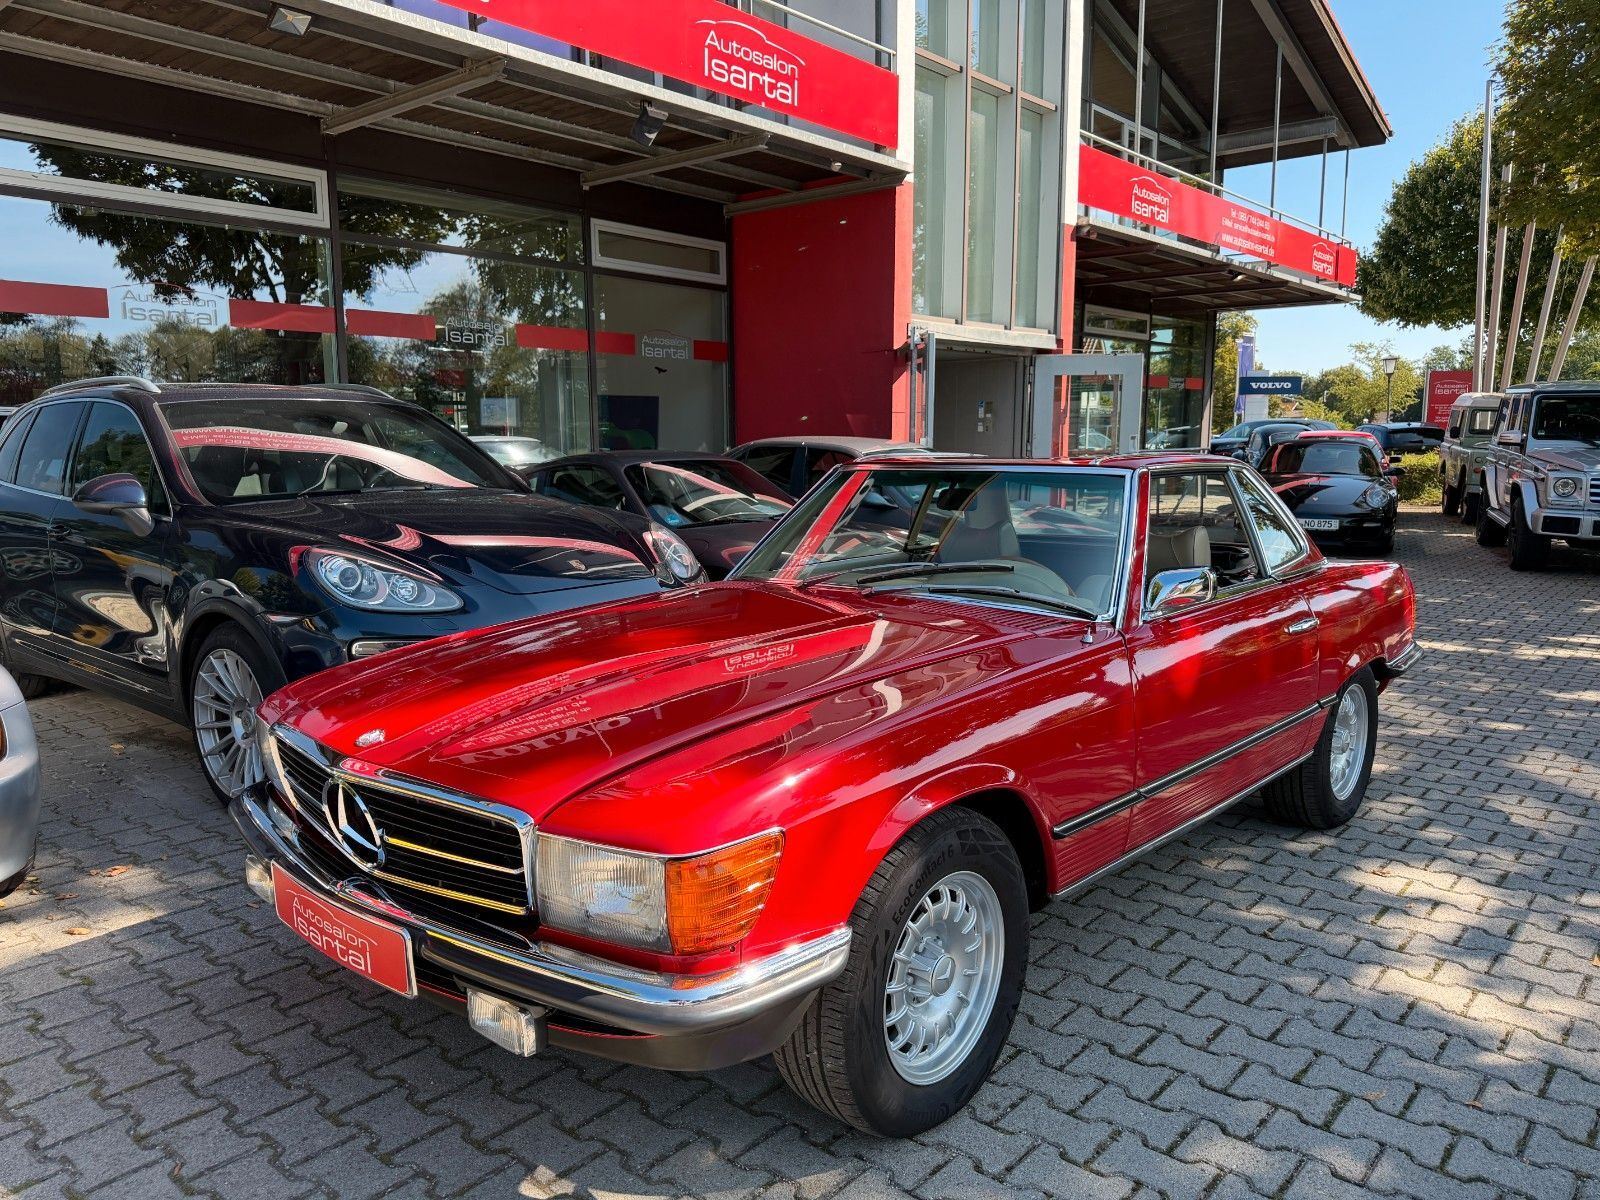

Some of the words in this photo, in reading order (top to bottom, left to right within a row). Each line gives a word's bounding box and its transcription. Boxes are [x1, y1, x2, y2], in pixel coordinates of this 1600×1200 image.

[704, 30, 799, 79] Autosalon
[704, 47, 799, 107] Isartal
[1132, 184, 1169, 206] Autosalon
[1131, 194, 1169, 223] Isartal
[1313, 248, 1334, 263] Autosalon
[1312, 257, 1335, 276] Isartal
[123, 289, 217, 308] Autosalon
[121, 301, 218, 326] Isartal
[445, 326, 509, 347] Isartal
[641, 335, 688, 346] Autosalon
[641, 343, 689, 360] Isartal
[1317, 520, 1333, 528] 875
[292, 897, 370, 952] Autosalon
[292, 906, 372, 975] Isartal
